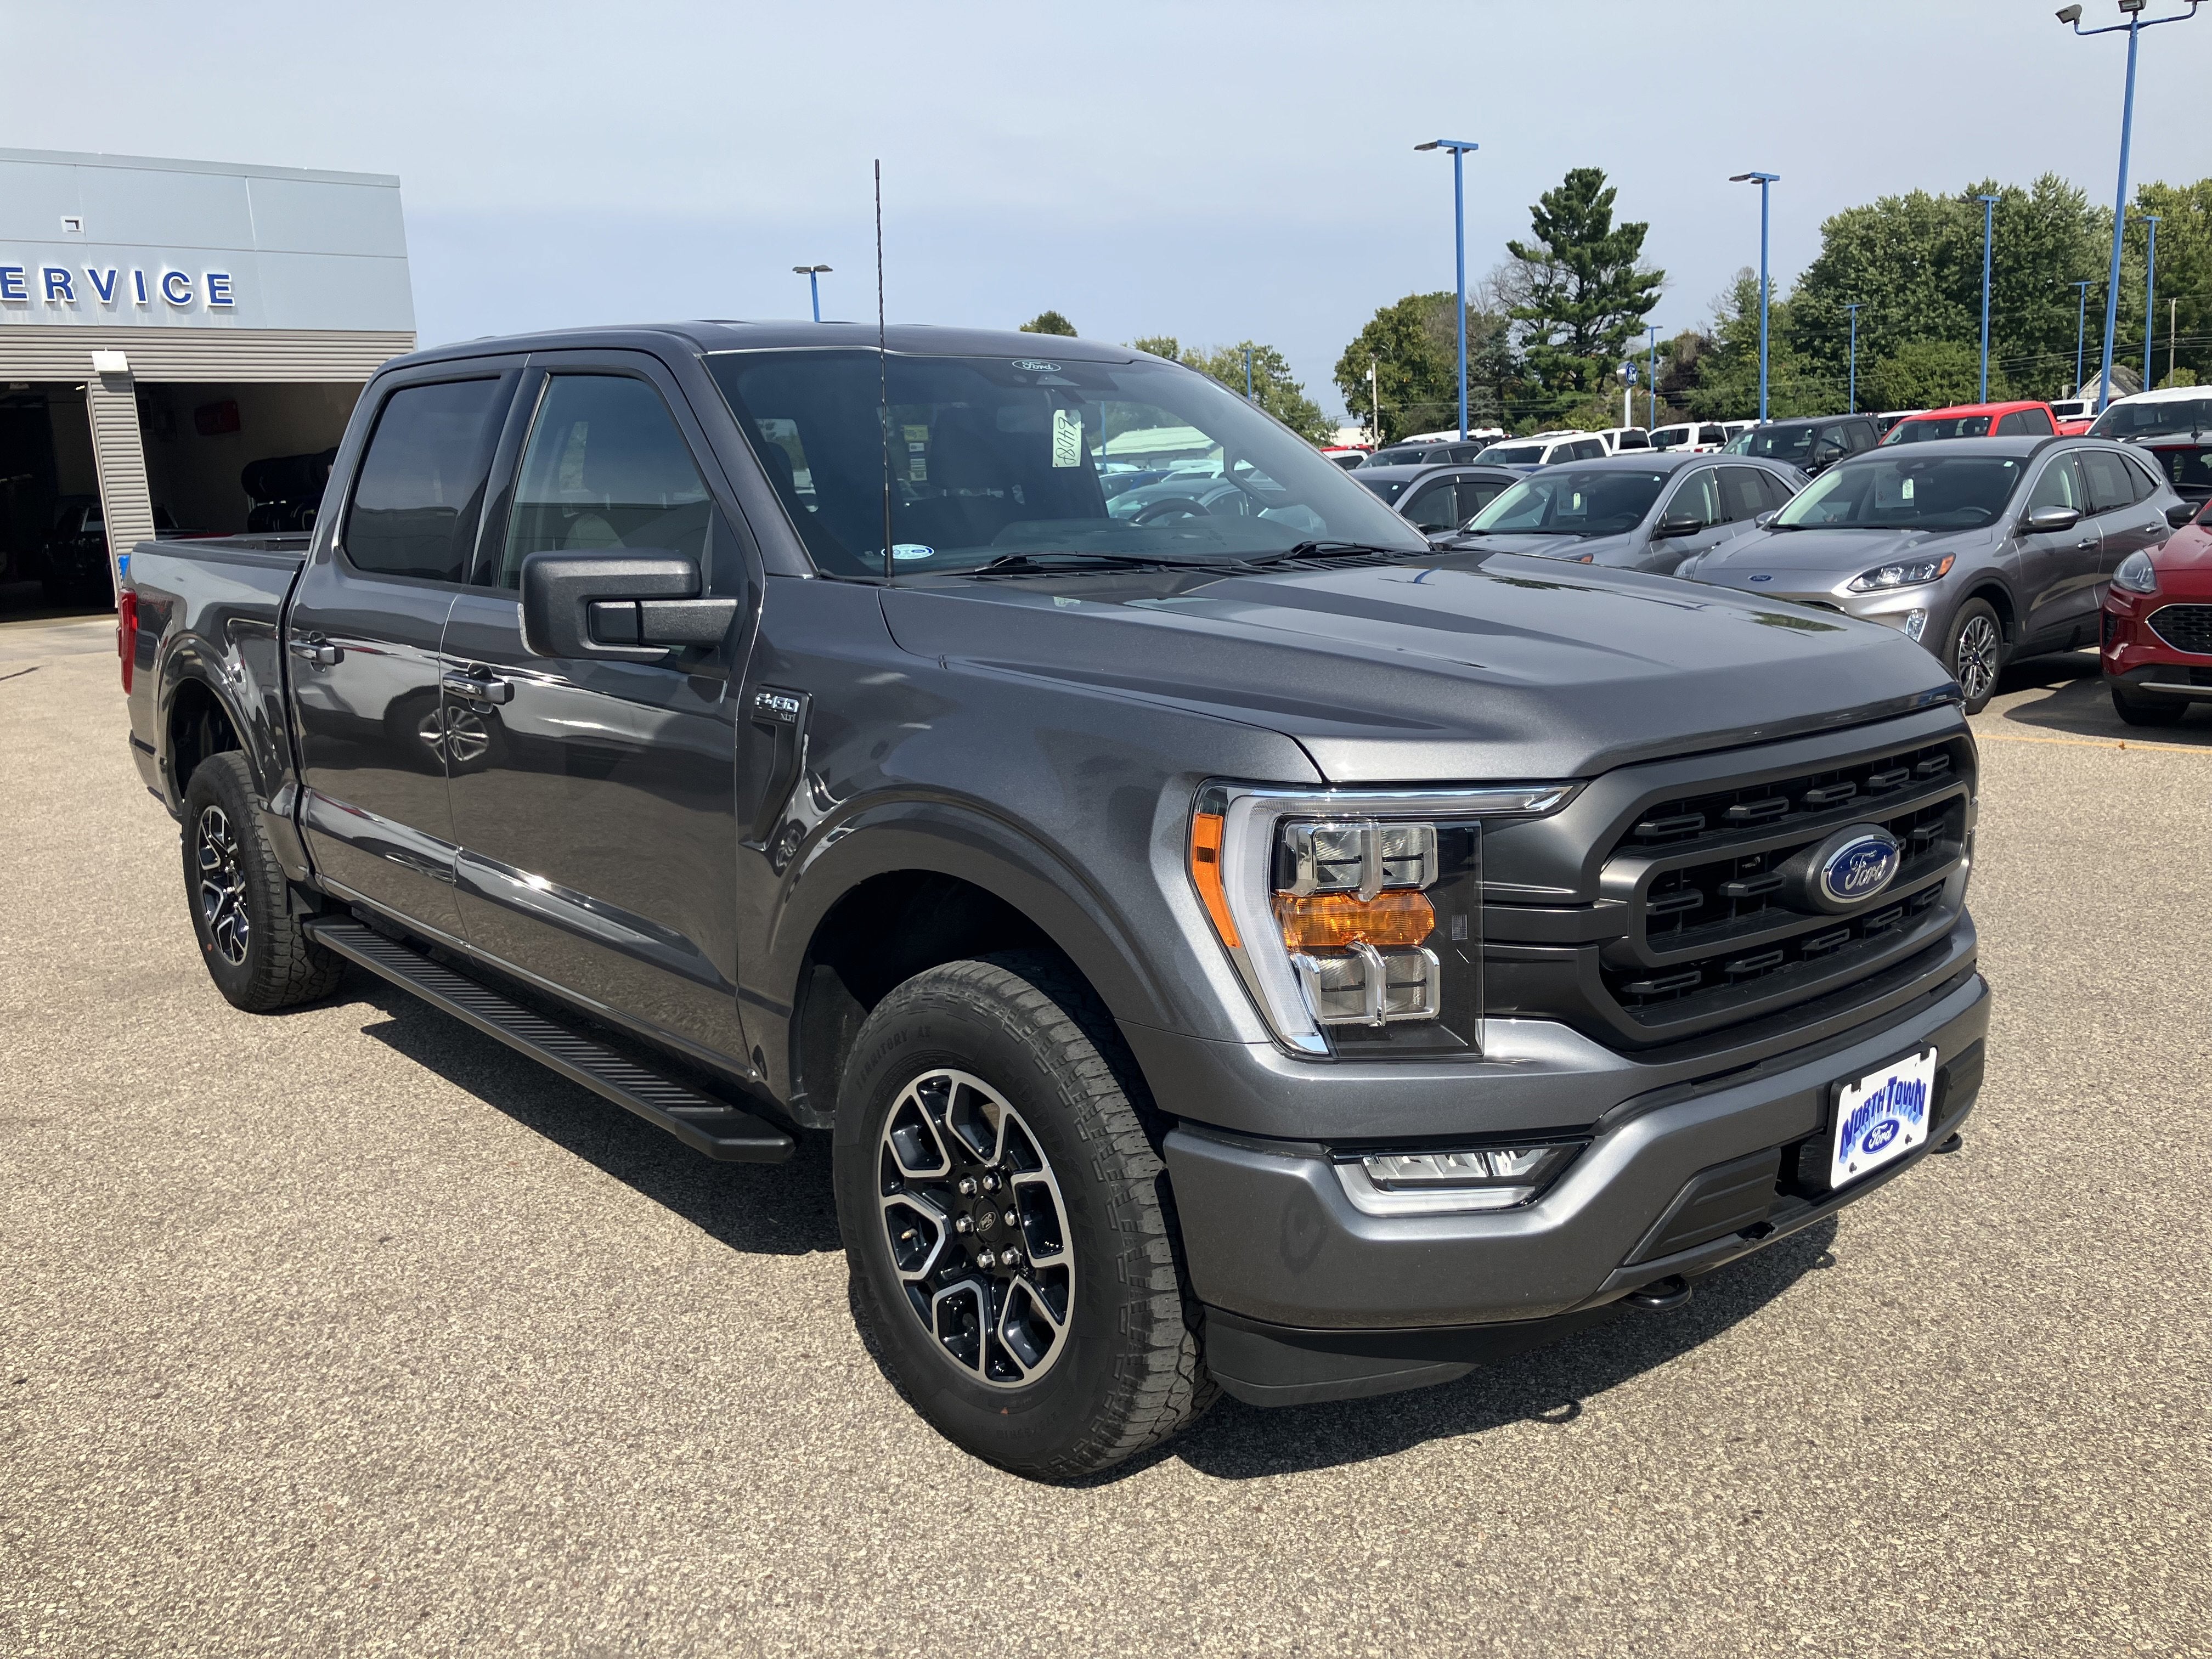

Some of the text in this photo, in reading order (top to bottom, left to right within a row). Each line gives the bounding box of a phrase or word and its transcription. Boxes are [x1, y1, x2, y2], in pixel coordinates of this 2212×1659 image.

[1022, 362, 1054, 370] Ford
[1844, 850, 1887, 890] Ford
[1839, 1076, 1927, 1163] NORTH TOWN
[1869, 1122, 1894, 1149] Ford
